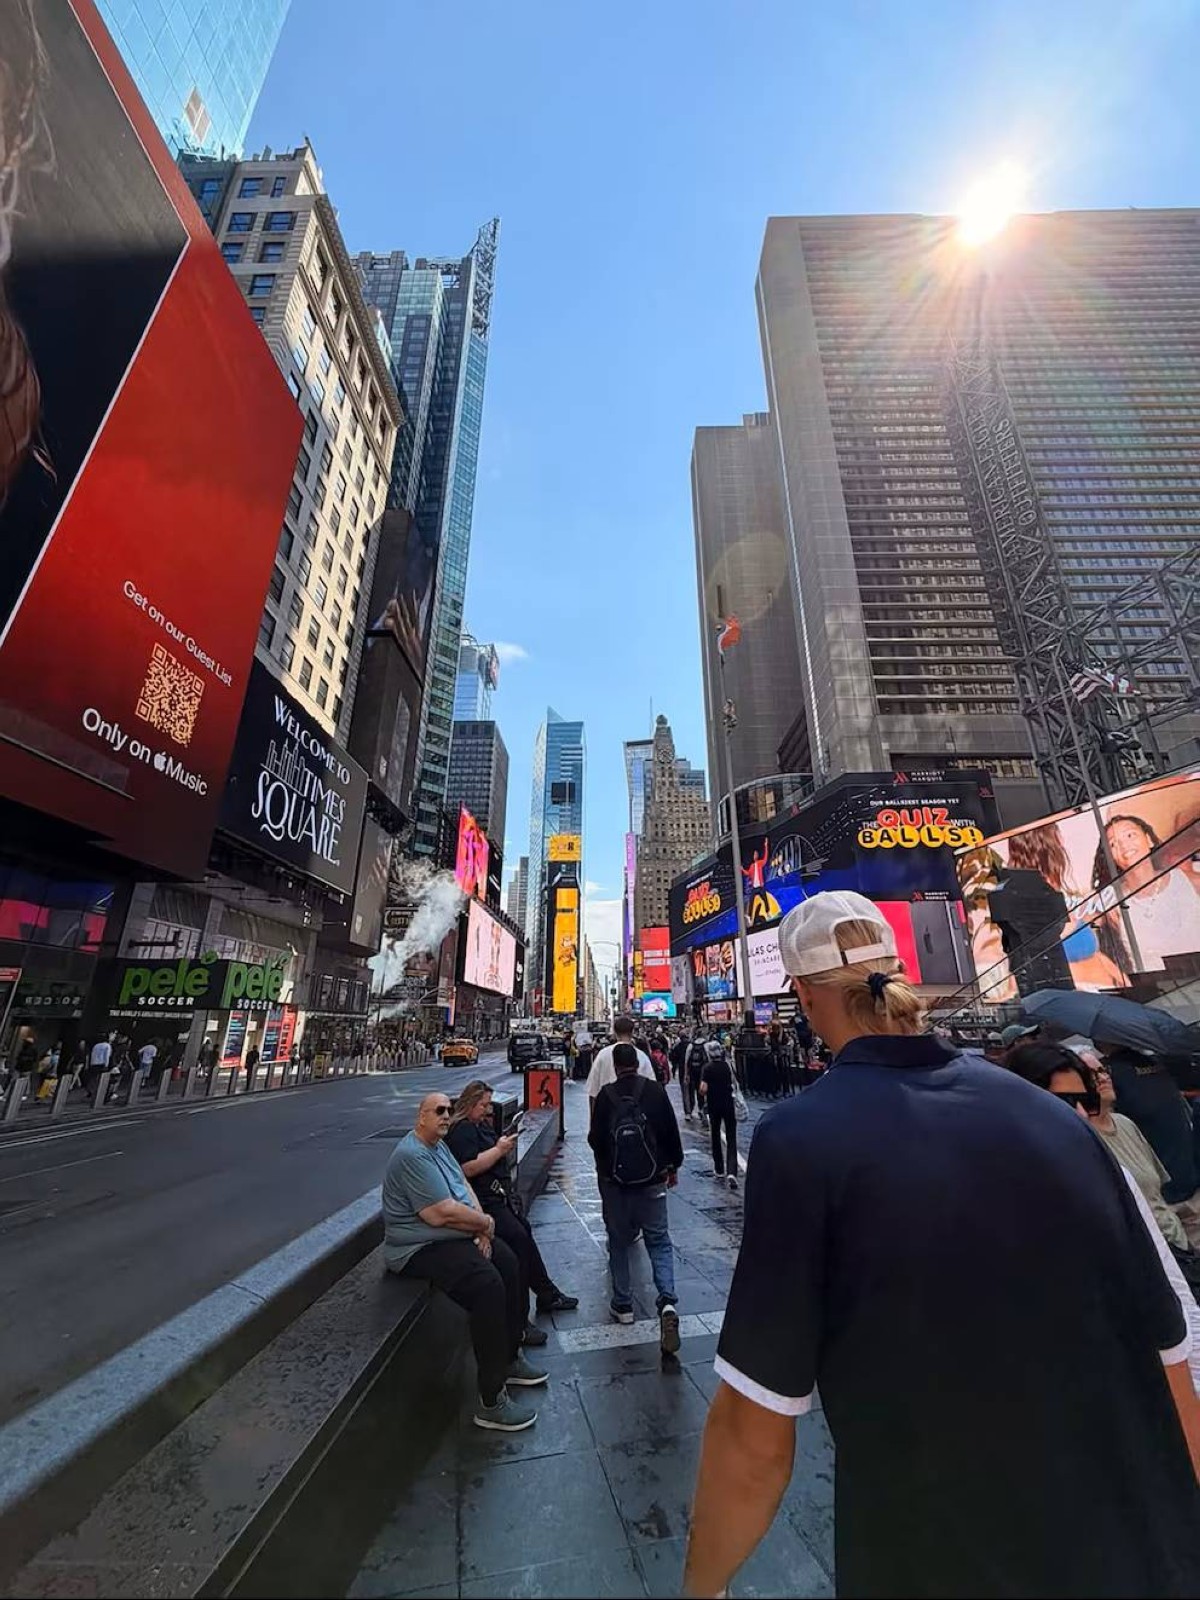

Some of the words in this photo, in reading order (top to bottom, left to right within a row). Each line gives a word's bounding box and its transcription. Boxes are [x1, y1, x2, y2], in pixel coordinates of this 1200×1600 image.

[993, 419, 1037, 526] OUTFITTERS
[124, 580, 149, 611] Get
[148, 606, 165, 626] on
[165, 621, 186, 643] our
[185, 637, 216, 671] Guest
[215, 663, 232, 687] List
[82, 707, 129, 751] Only
[129, 740, 151, 764] on
[165, 756, 208, 796] Music
[274, 695, 336, 773] WELCOME
[336, 763, 351, 785] TO
[251, 770, 341, 867] SQUARE
[303, 767, 347, 824] TIMES
[859, 825, 981, 847] BALLS!
[861, 820, 879, 829] THE
[877, 807, 950, 828] QUIZ
[950, 819, 976, 827] WITH
[138, 996, 196, 1006] SOCCER
[236, 998, 274, 1010] SOCCER
